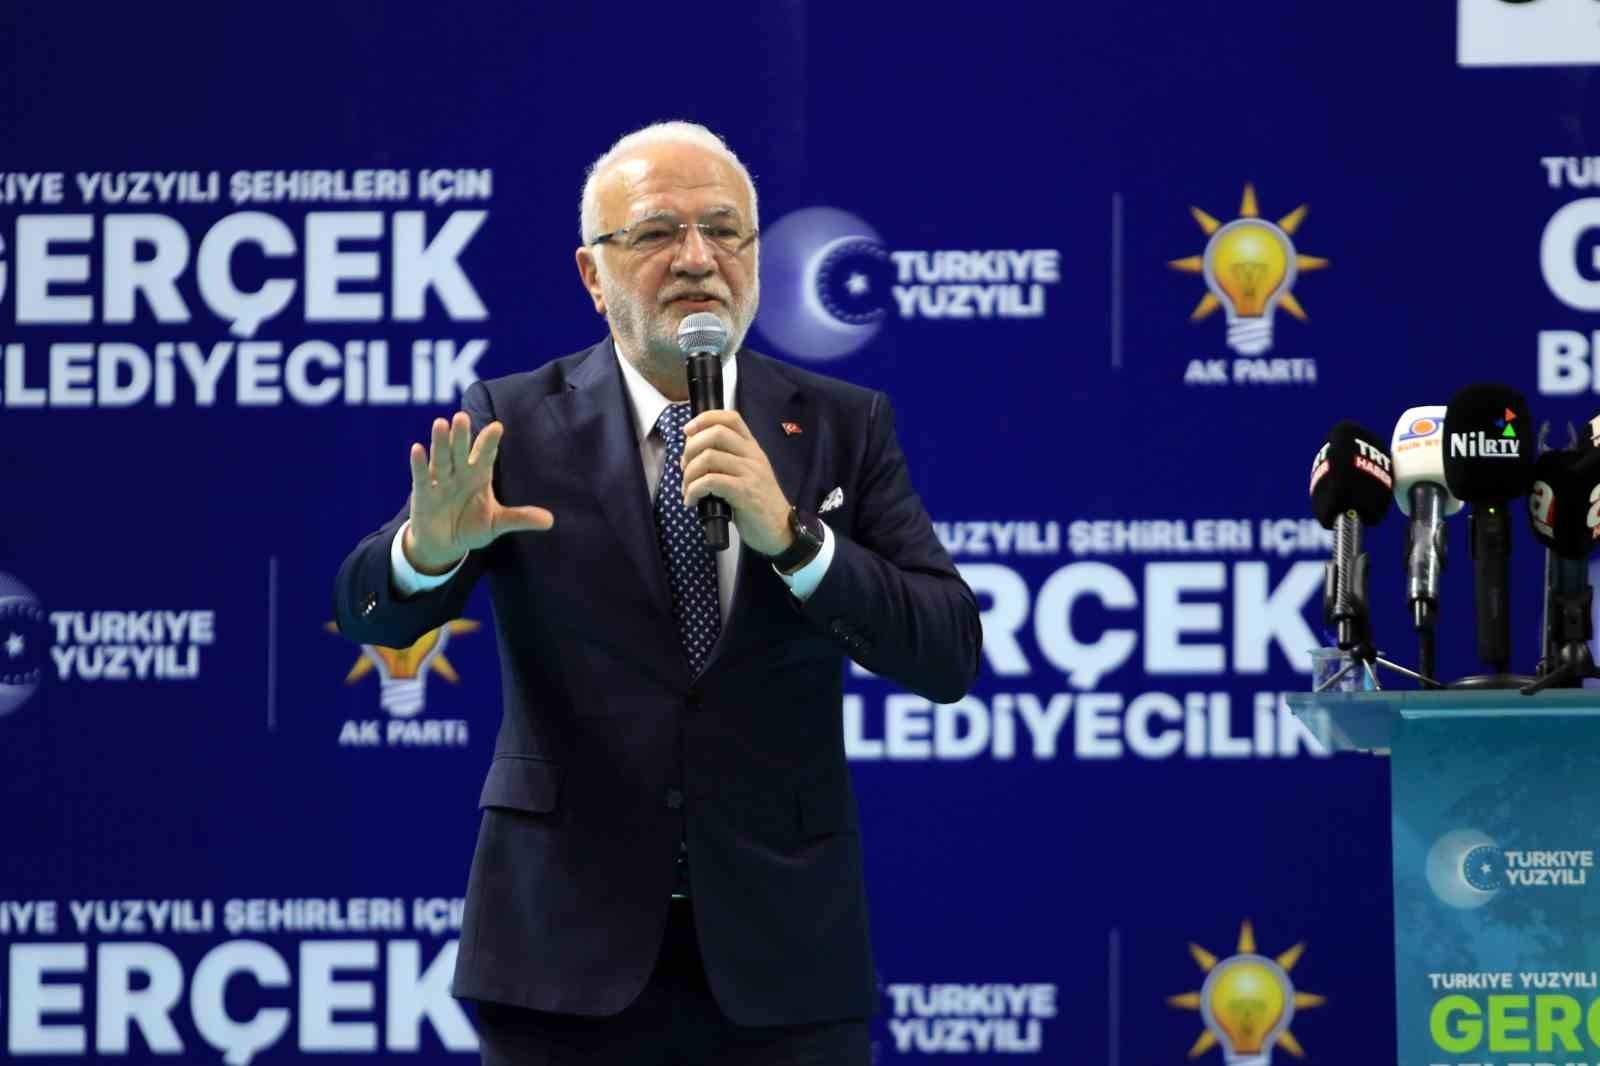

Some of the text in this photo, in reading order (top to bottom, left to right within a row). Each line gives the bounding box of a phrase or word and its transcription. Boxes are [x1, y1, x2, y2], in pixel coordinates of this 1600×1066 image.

[0, 172, 64, 203] İYE
[0, 210, 489, 338] ERÇEK
[0, 339, 488, 407] LEDİYECİLİK
[1184, 359, 1228, 384] AK
[1537, 329, 1600, 395] B
[851, 561, 1323, 690] RÇEK
[339, 720, 381, 745] AK
[413, 898, 466, 936] İÇİ
